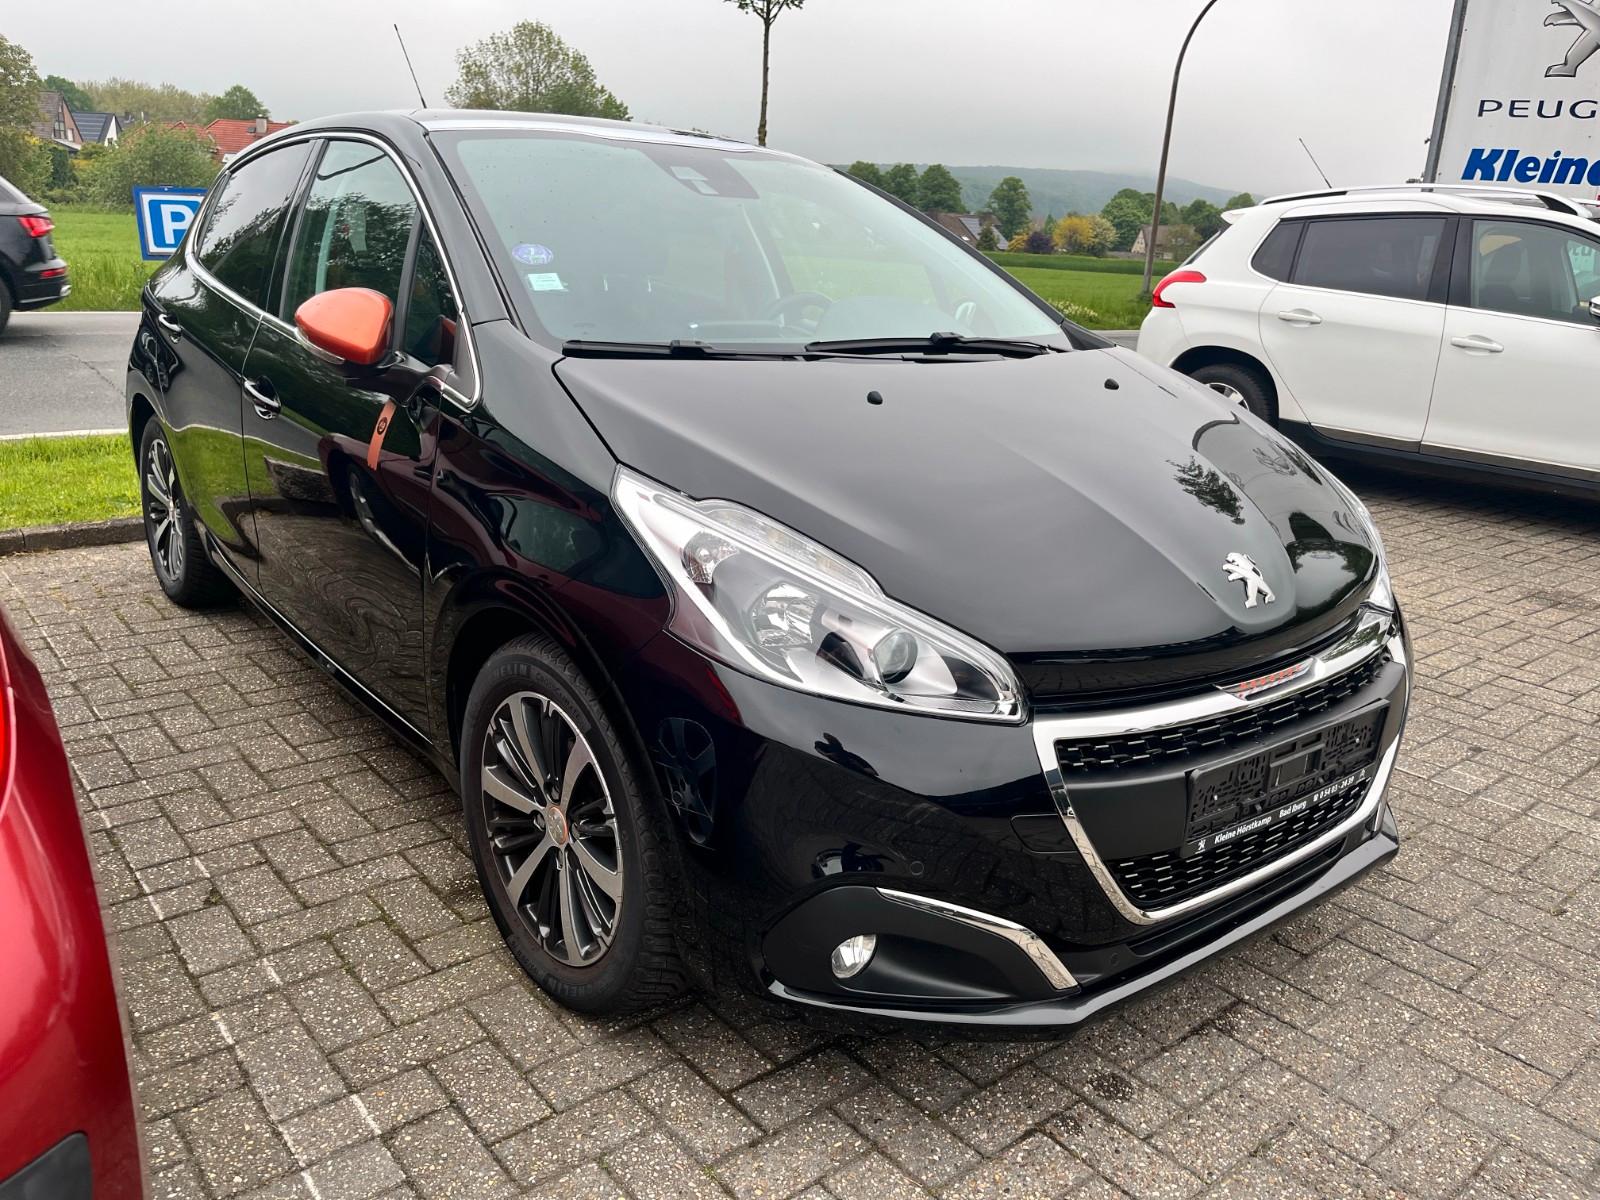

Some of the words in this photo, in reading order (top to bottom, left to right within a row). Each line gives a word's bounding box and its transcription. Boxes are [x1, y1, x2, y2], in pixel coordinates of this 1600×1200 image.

[1478, 99, 1598, 119] PEUG
[161, 204, 195, 245] P
[1214, 830, 1237, 844] Kleine
[1236, 816, 1272, 835] Hörstkamp
[1279, 805, 1292, 818] Bad
